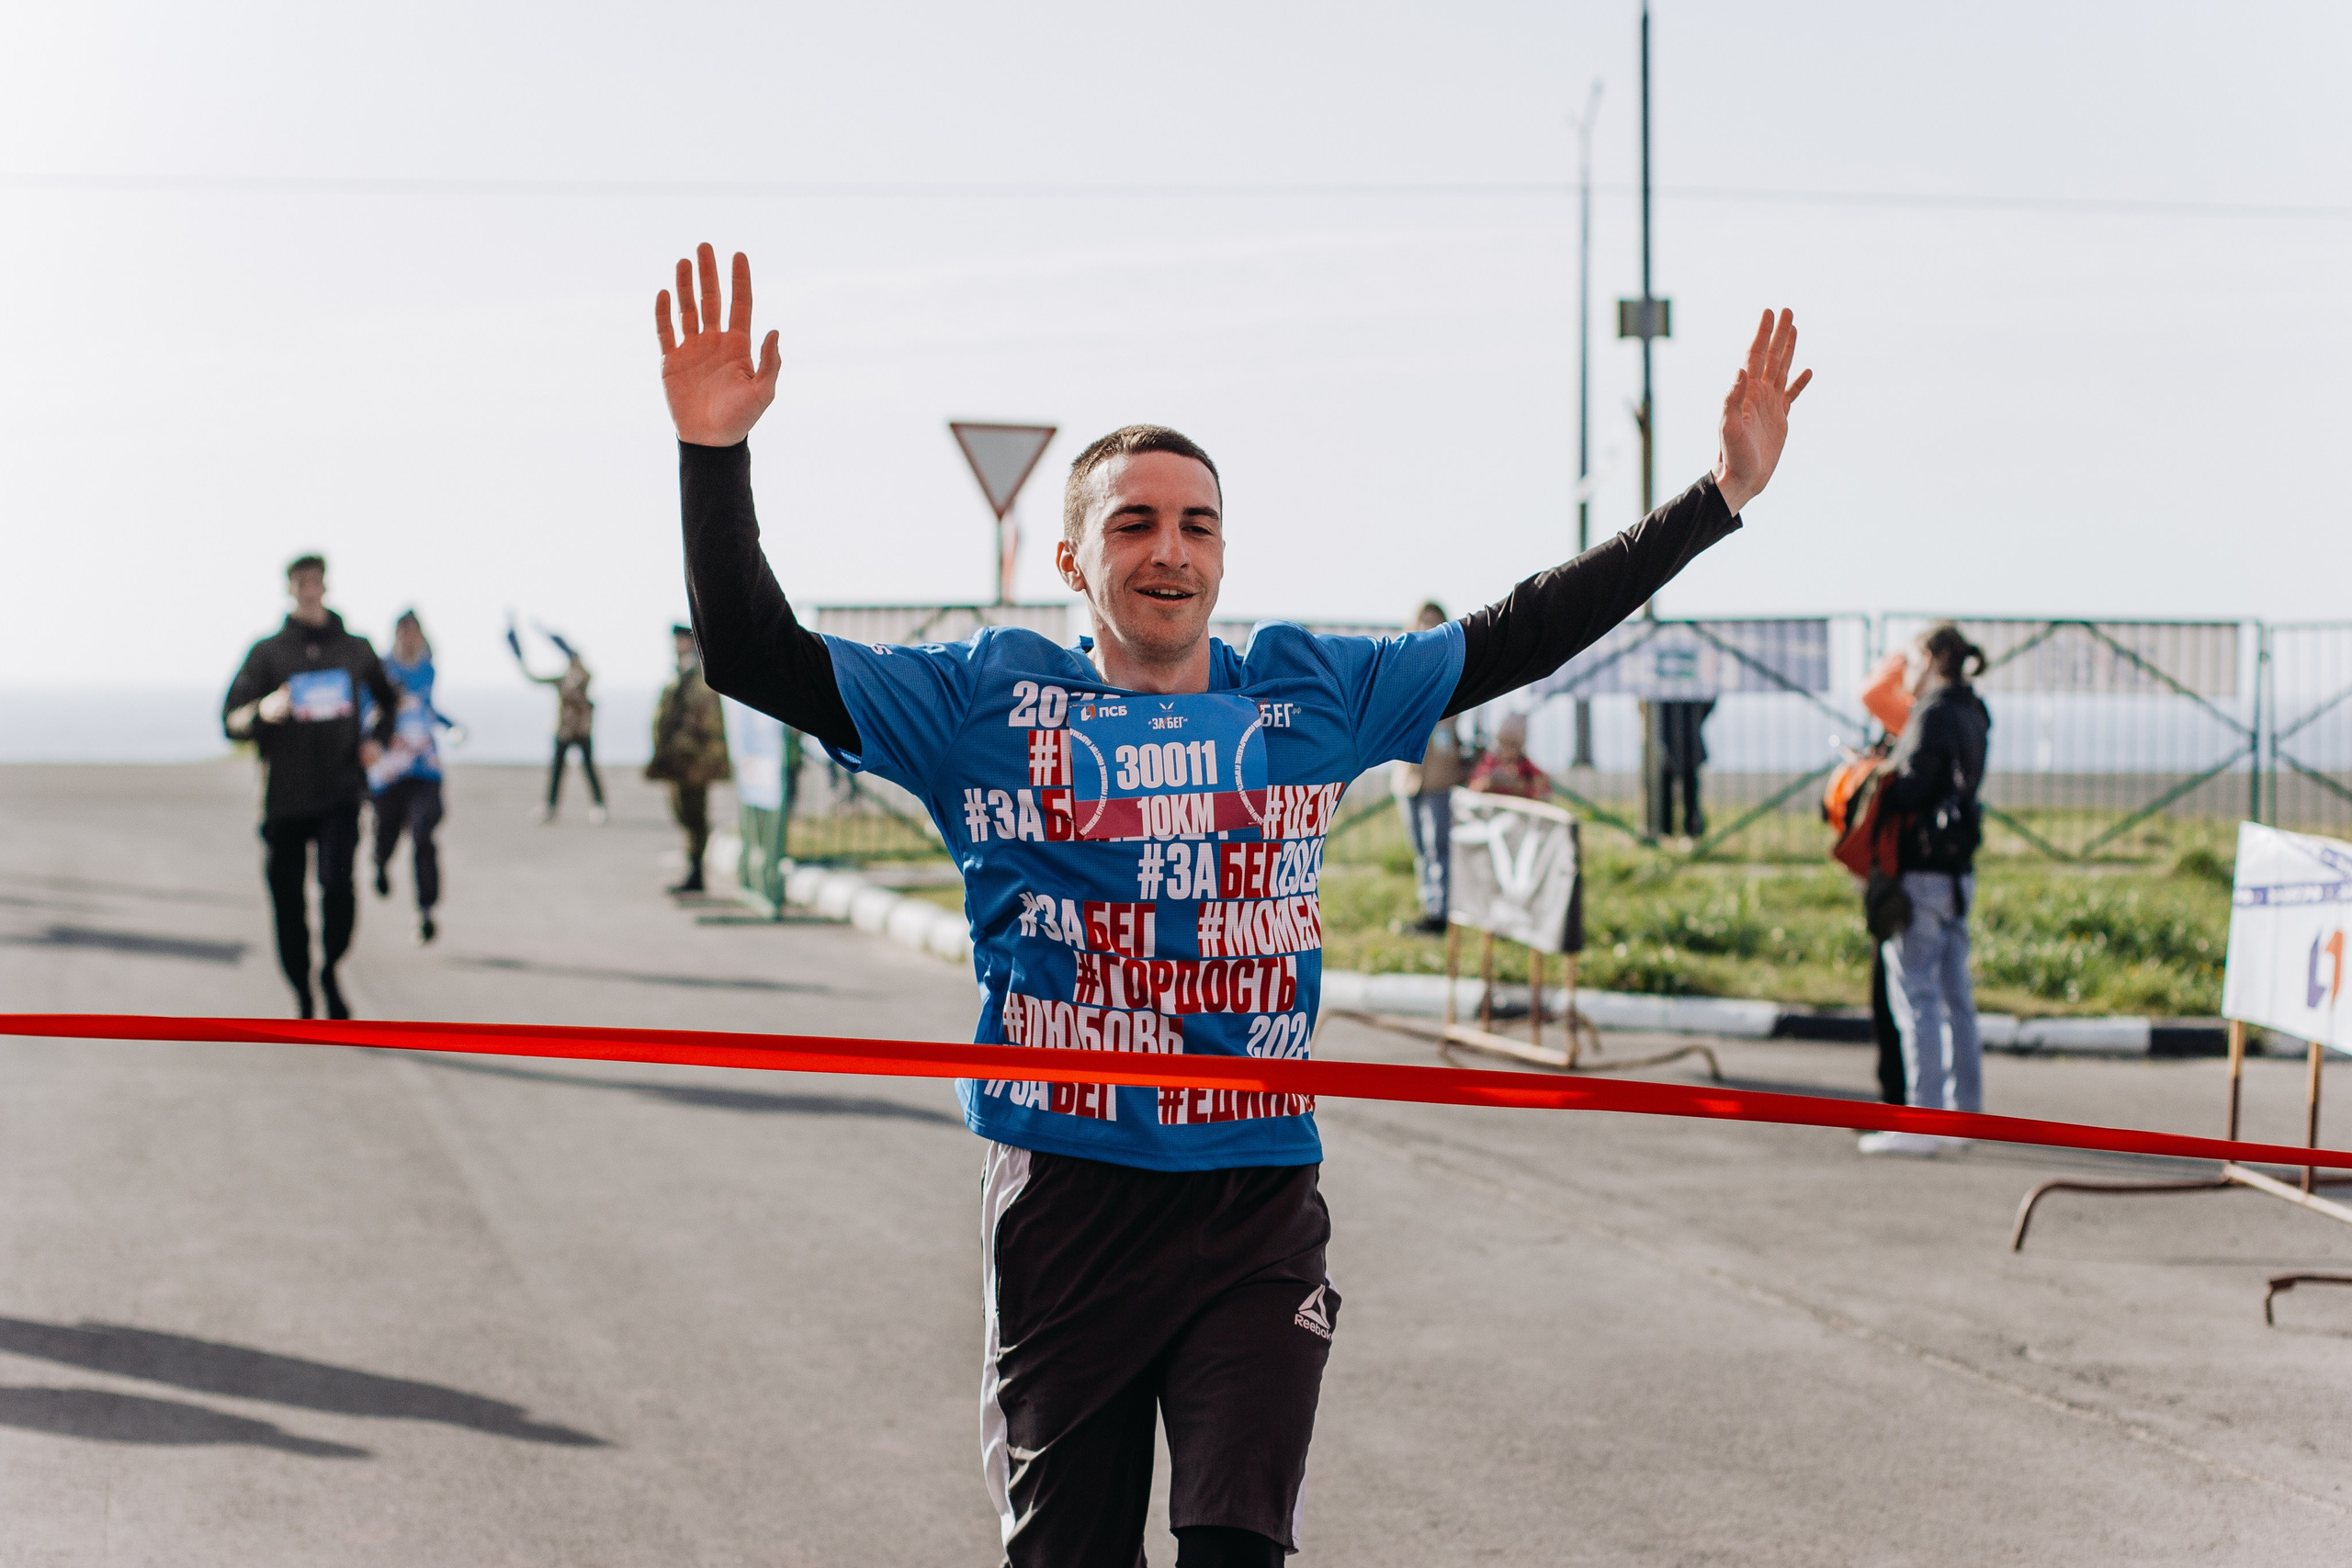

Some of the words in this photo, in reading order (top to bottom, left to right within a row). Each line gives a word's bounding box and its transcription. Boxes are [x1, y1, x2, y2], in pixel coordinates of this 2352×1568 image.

[1099, 705, 1128, 717] ПСБ
[1115, 740, 1217, 790] 30011
[1136, 793, 1216, 837] 10КМ
[1018, 891, 1156, 957] #ЗАБЕГ
[1075, 953, 1296, 1015] #ГОРДОСТЬ
[1003, 992, 1184, 1055] #ЛЮБОВЬ
[1294, 1313, 1332, 1343] Reebok
